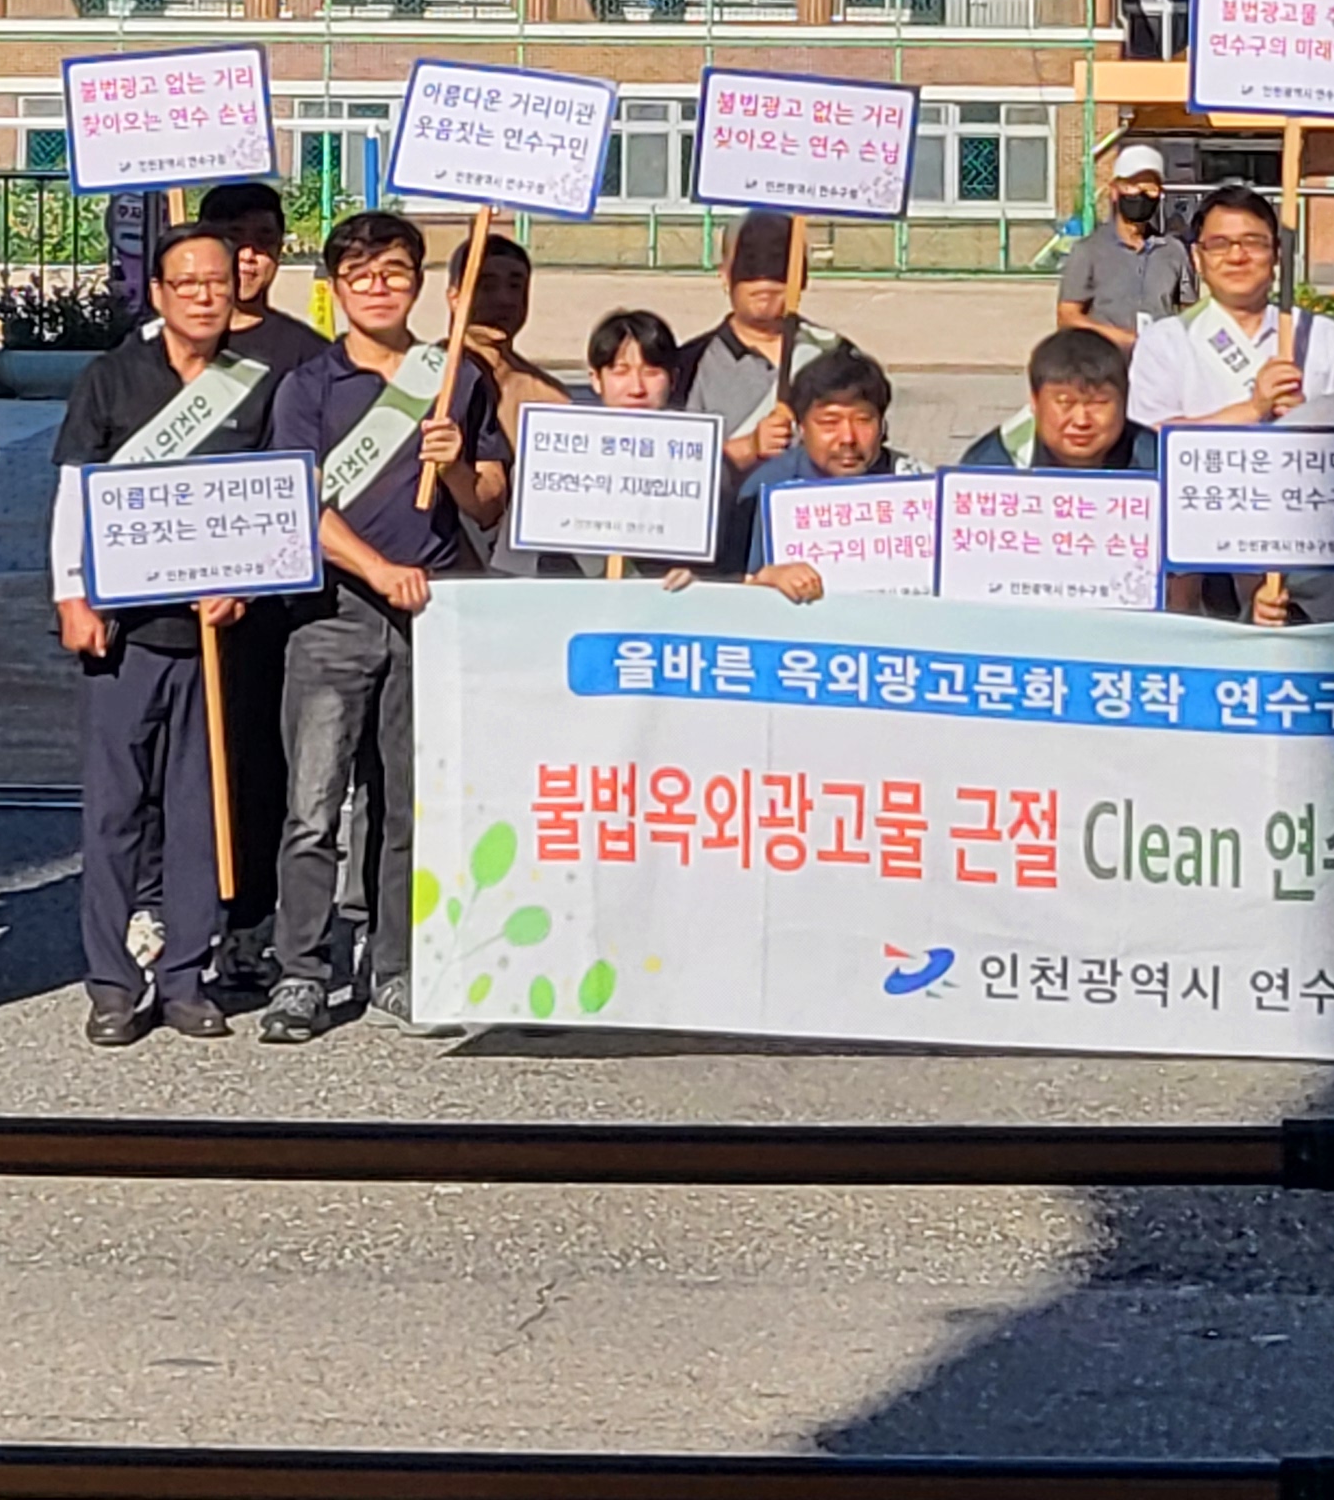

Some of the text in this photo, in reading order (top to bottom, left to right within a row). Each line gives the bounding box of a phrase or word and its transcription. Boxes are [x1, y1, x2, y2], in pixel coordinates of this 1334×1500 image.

[1222, 0, 1318, 26] 불법광고물
[1209, 32, 1288, 57] 연수구의
[79, 65, 255, 104] 불법광고 없는 거리
[422, 81, 597, 126] 아름다운 거리미관
[81, 99, 259, 138] 찾아오는 연수 손님
[716, 90, 905, 129] 불법광고 없는 거리
[413, 115, 590, 161] 웃음짓는 연수구민
[713, 125, 901, 166] 찾아오는 연수 손님
[534, 431, 590, 455] 안전한
[667, 438, 704, 461] 위해
[1179, 448, 1272, 475] 아름다운
[101, 475, 295, 511] 아름다운 거리미관
[953, 491, 1151, 521] 불법광고 없는 거리
[1178, 485, 1272, 512] 웃음짓는
[103, 510, 298, 548] 웃음짓는 연수구민
[794, 500, 895, 530] 불법광고물
[950, 527, 1151, 560] 찾아오는 연수 손님
[612, 640, 758, 694] 올바른
[776, 648, 1069, 717] 옥외광고문화
[1089, 669, 1185, 722] 정착
[530, 760, 929, 881] 불법옥외광고물
[948, 786, 1060, 890] 근절
[1081, 798, 1242, 889] Clean
[978, 952, 1222, 1010] 인천광역시
